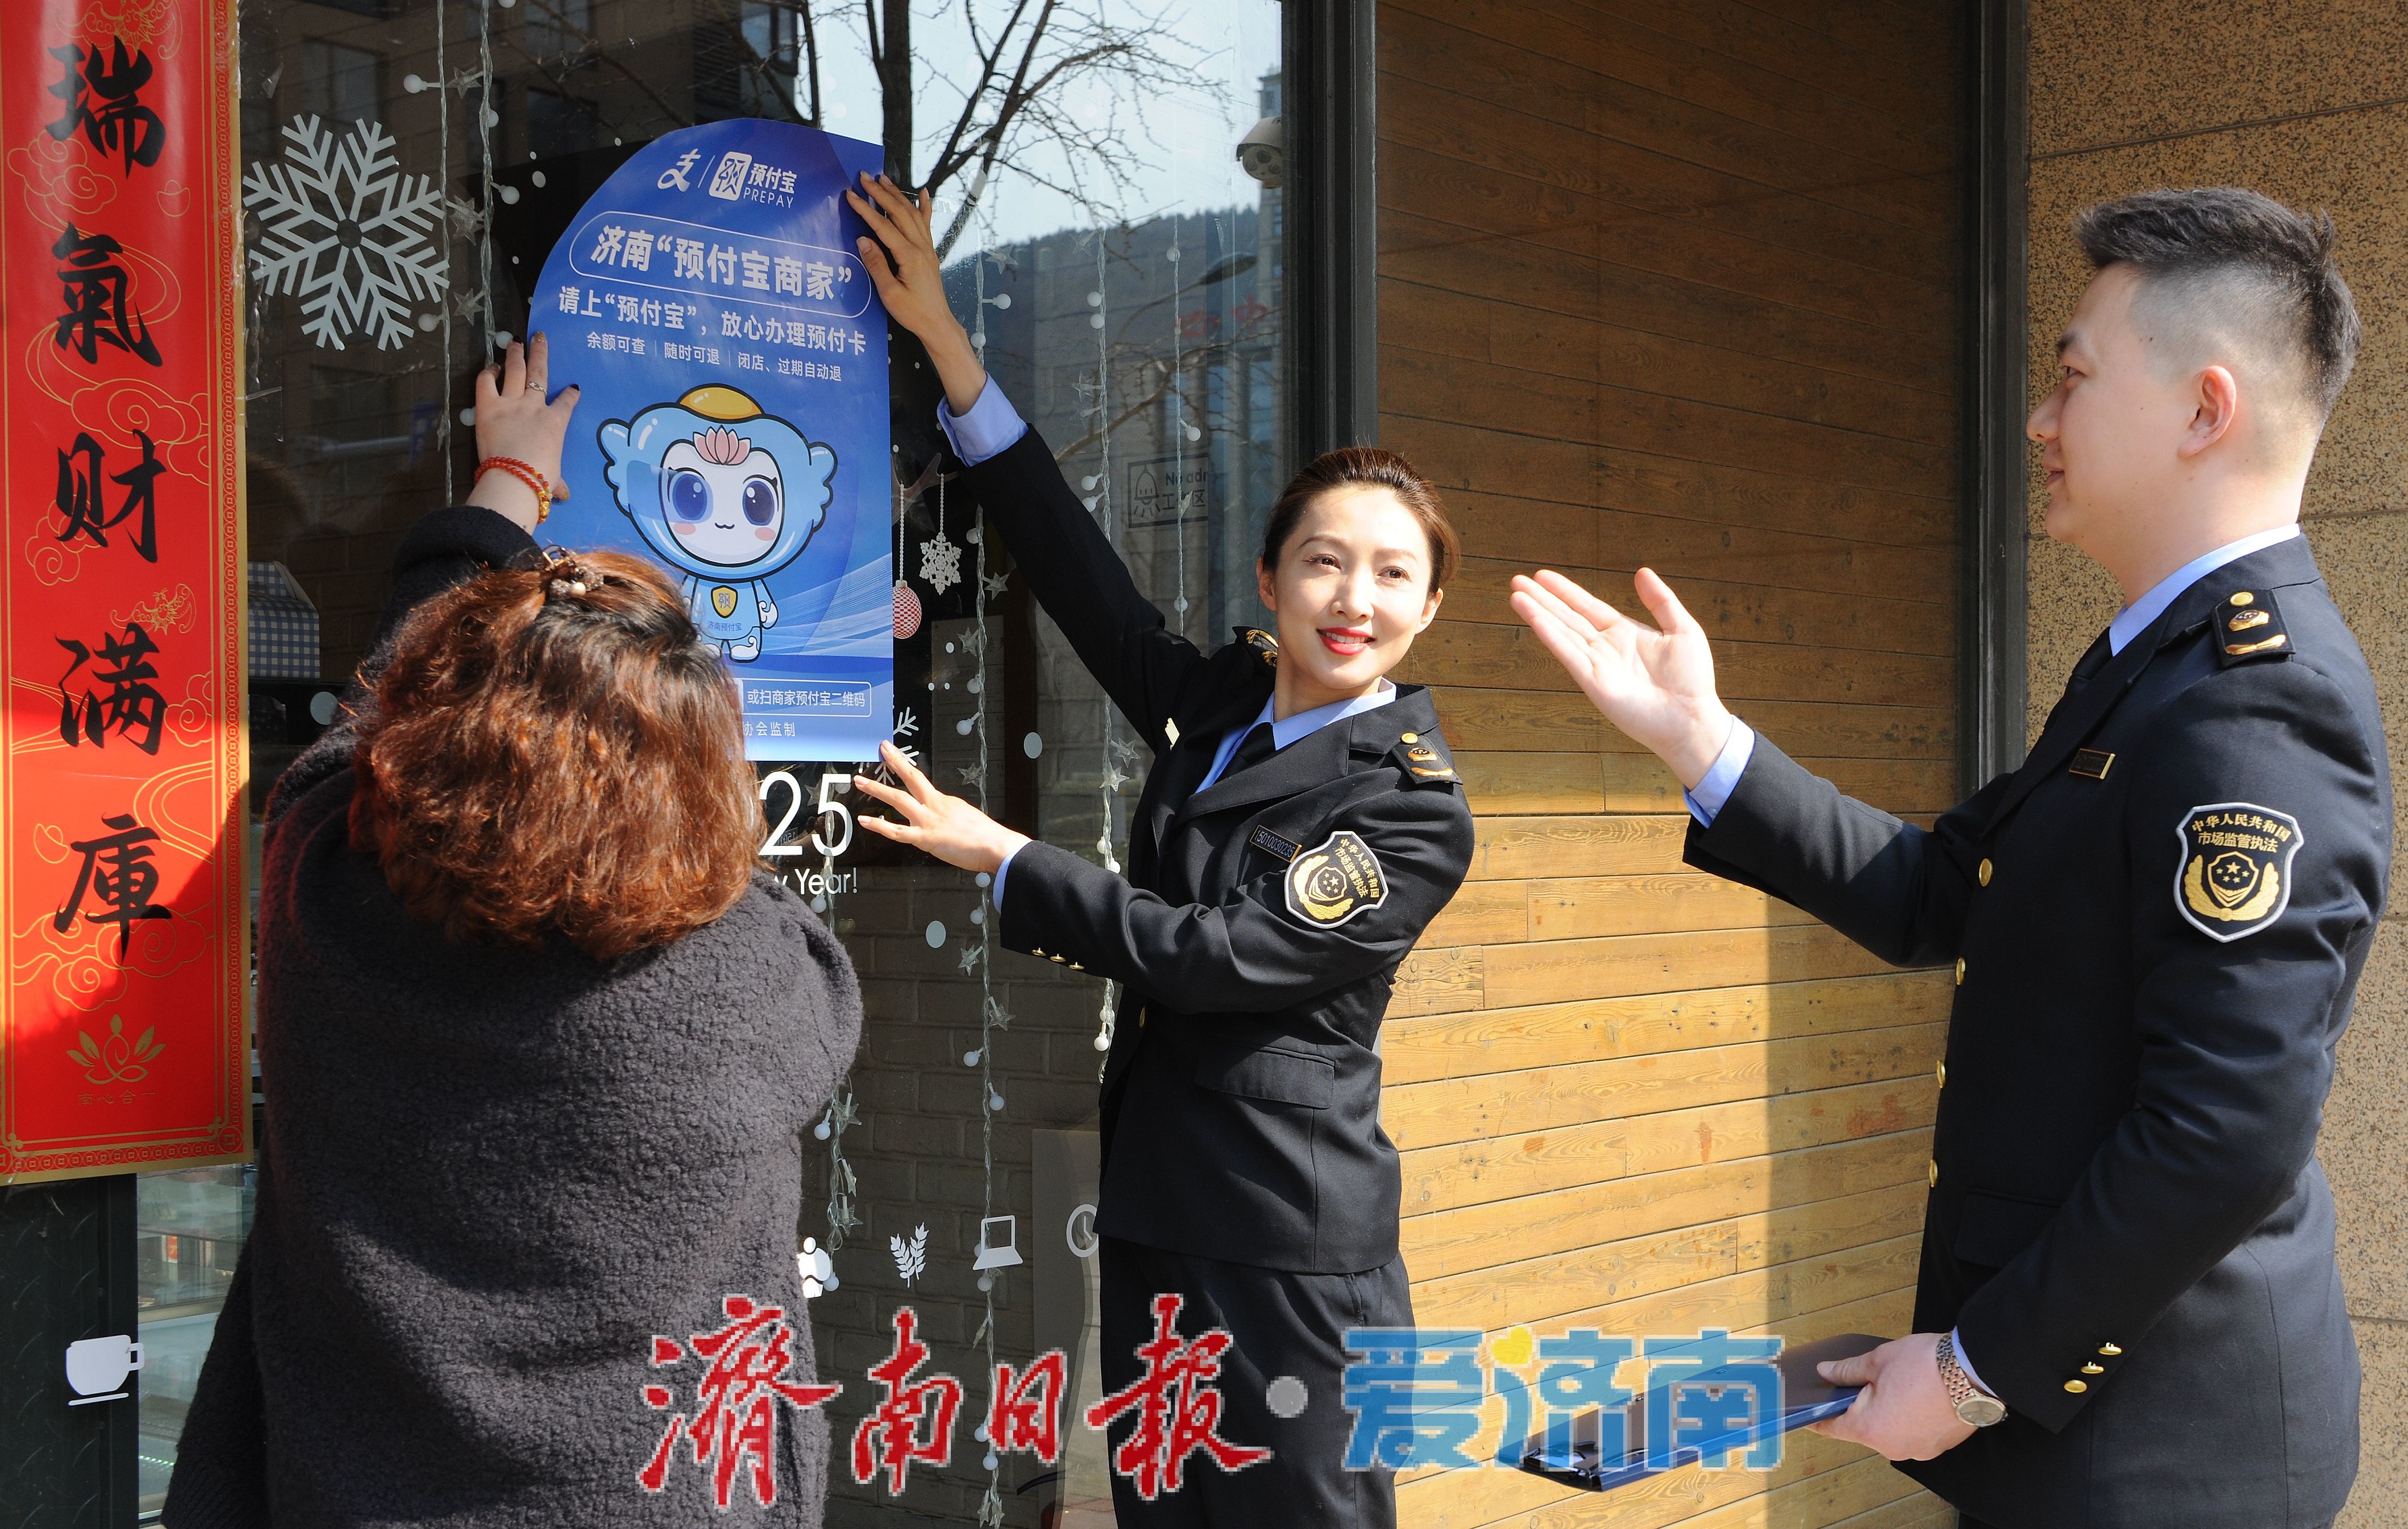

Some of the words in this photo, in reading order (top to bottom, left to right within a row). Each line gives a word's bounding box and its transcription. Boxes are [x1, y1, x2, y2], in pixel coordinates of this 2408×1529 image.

[747, 163, 797, 194] 预付宝
[744, 187, 794, 209] PREPAY
[586, 332, 645, 355] 余额可查
[664, 342, 720, 365] 随时可退
[738, 352, 842, 381] 闭店、过期自动退
[1163, 489, 1205, 510] 工区
[707, 621, 742, 632] 济南预付宝
[747, 688, 865, 707] 或扫商家预付宝二维码
[758, 771, 853, 857] 25
[2191, 813, 2292, 842] 中华人民共和国
[1254, 829, 1296, 858] 15010030235
[2198, 831, 2279, 853] 市场监管执法
[794, 867, 857, 895] Year!
[1334, 847, 1369, 899] 市场监管执法
[1340, 839, 1379, 898] 中华人民共和国
